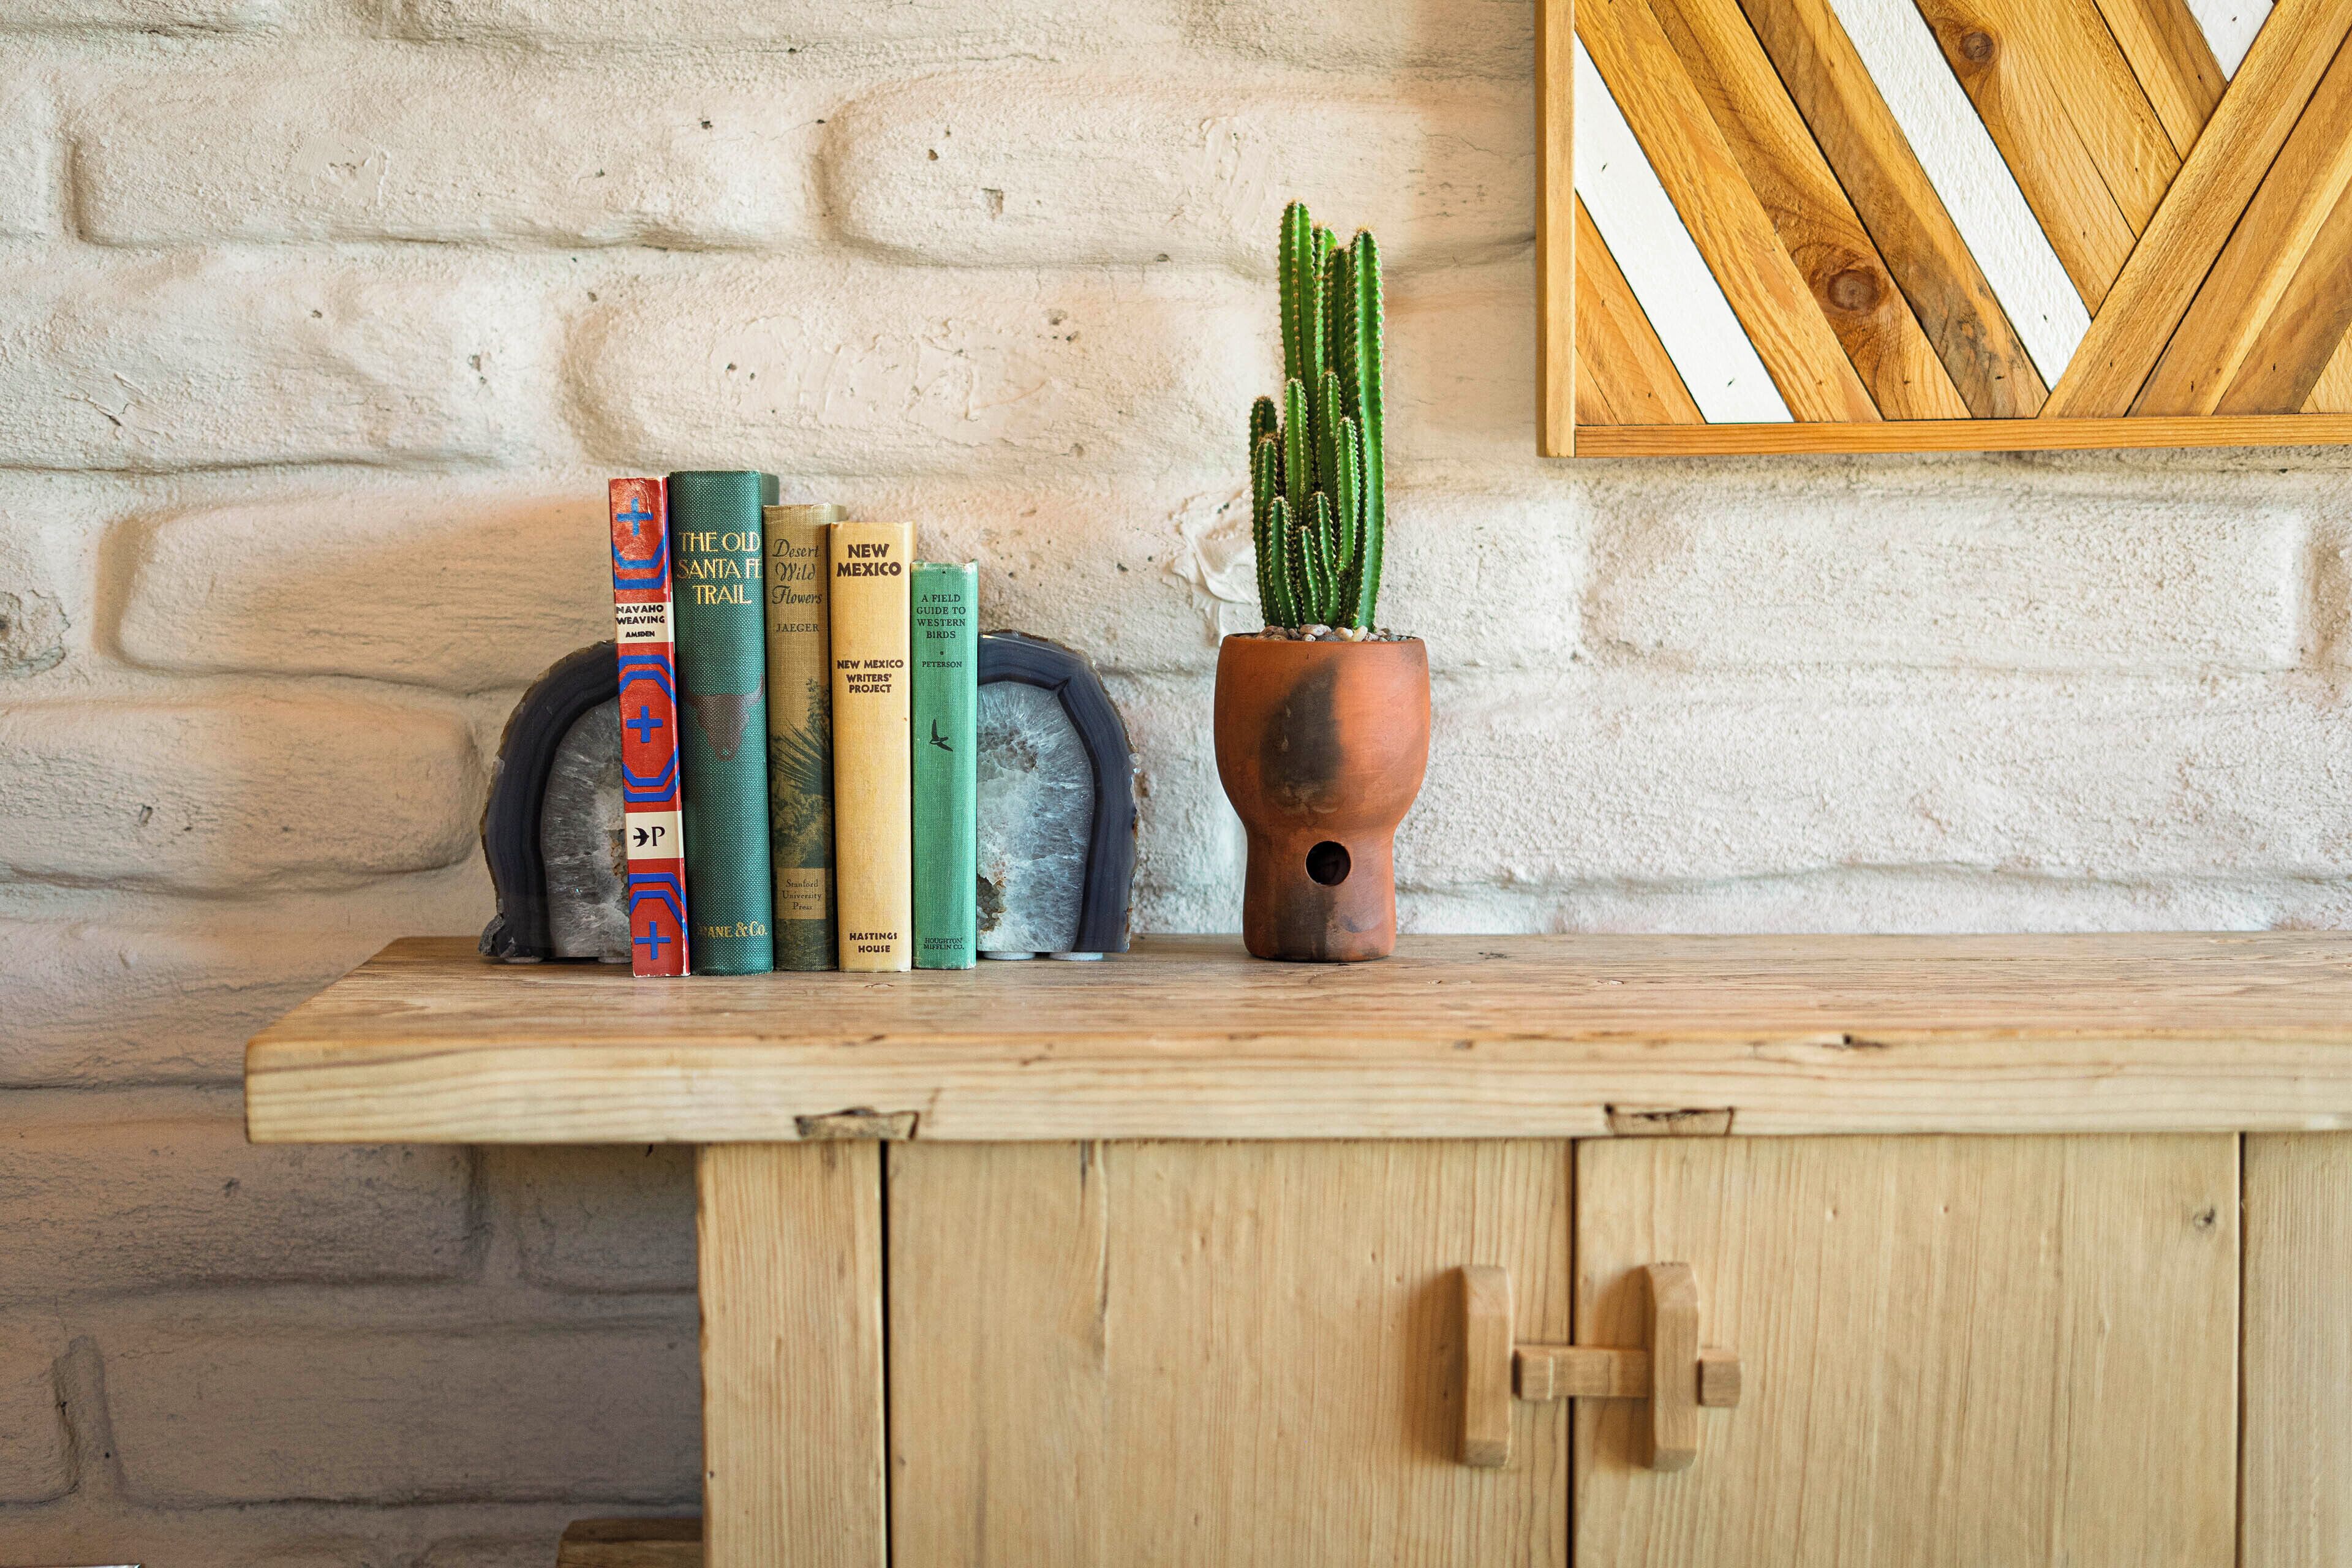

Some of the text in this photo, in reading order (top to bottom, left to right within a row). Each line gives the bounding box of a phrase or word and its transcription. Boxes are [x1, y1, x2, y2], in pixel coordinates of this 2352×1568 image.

[679, 531, 761, 552] THE OLD
[772, 538, 820, 558] Desert
[847, 543, 890, 559] NEW
[676, 558, 762, 579] SANTA FE
[775, 562, 816, 582] Wild
[836, 562, 902, 577] MEXICO
[692, 583, 752, 605] TRAIL
[772, 585, 823, 605] Flowers
[921, 594, 961, 603] A FIELD
[616, 605, 664, 614] NAVAHO
[616, 616, 665, 625] WEAVING
[916, 618, 966, 627] WESTERN
[776, 623, 820, 632] JAEGER
[926, 630, 956, 639] BIRDS
[837, 659, 904, 669] NEW MEXICO
[849, 684, 892, 693] PROJECT
[651, 826, 666, 847] P
[785, 878, 819, 888] Stanford
[782, 890, 822, 901] University
[792, 902, 813, 910] Press
[849, 932, 897, 941] HASTINGS
